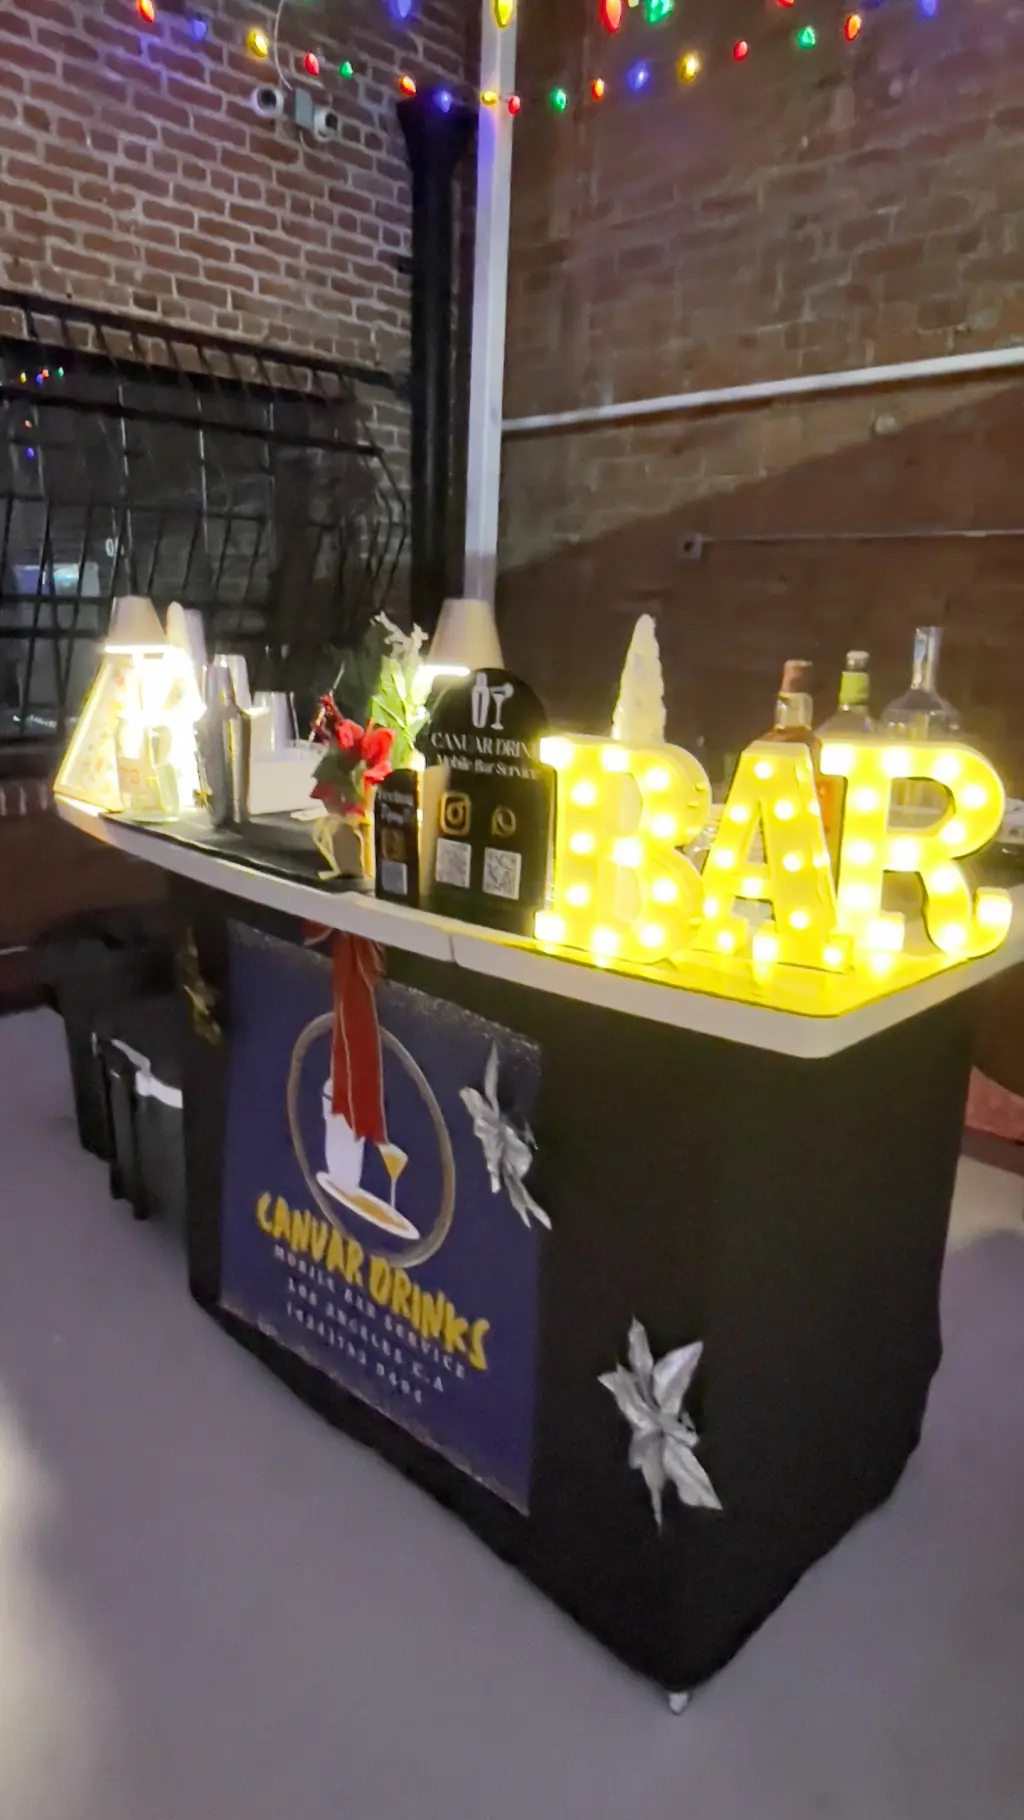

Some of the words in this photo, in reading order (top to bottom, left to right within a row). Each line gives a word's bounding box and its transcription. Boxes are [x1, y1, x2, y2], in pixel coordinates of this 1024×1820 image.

[534, 733, 1012, 976] BAR
[274, 1244, 335, 1293] MOBILE
[344, 1288, 375, 1319] BAR
[384, 1314, 465, 1380] SERVICE
[288, 1276, 318, 1308] LOS
[326, 1302, 403, 1364] ANGELES
[369, 1254, 491, 1371] DRINKS
